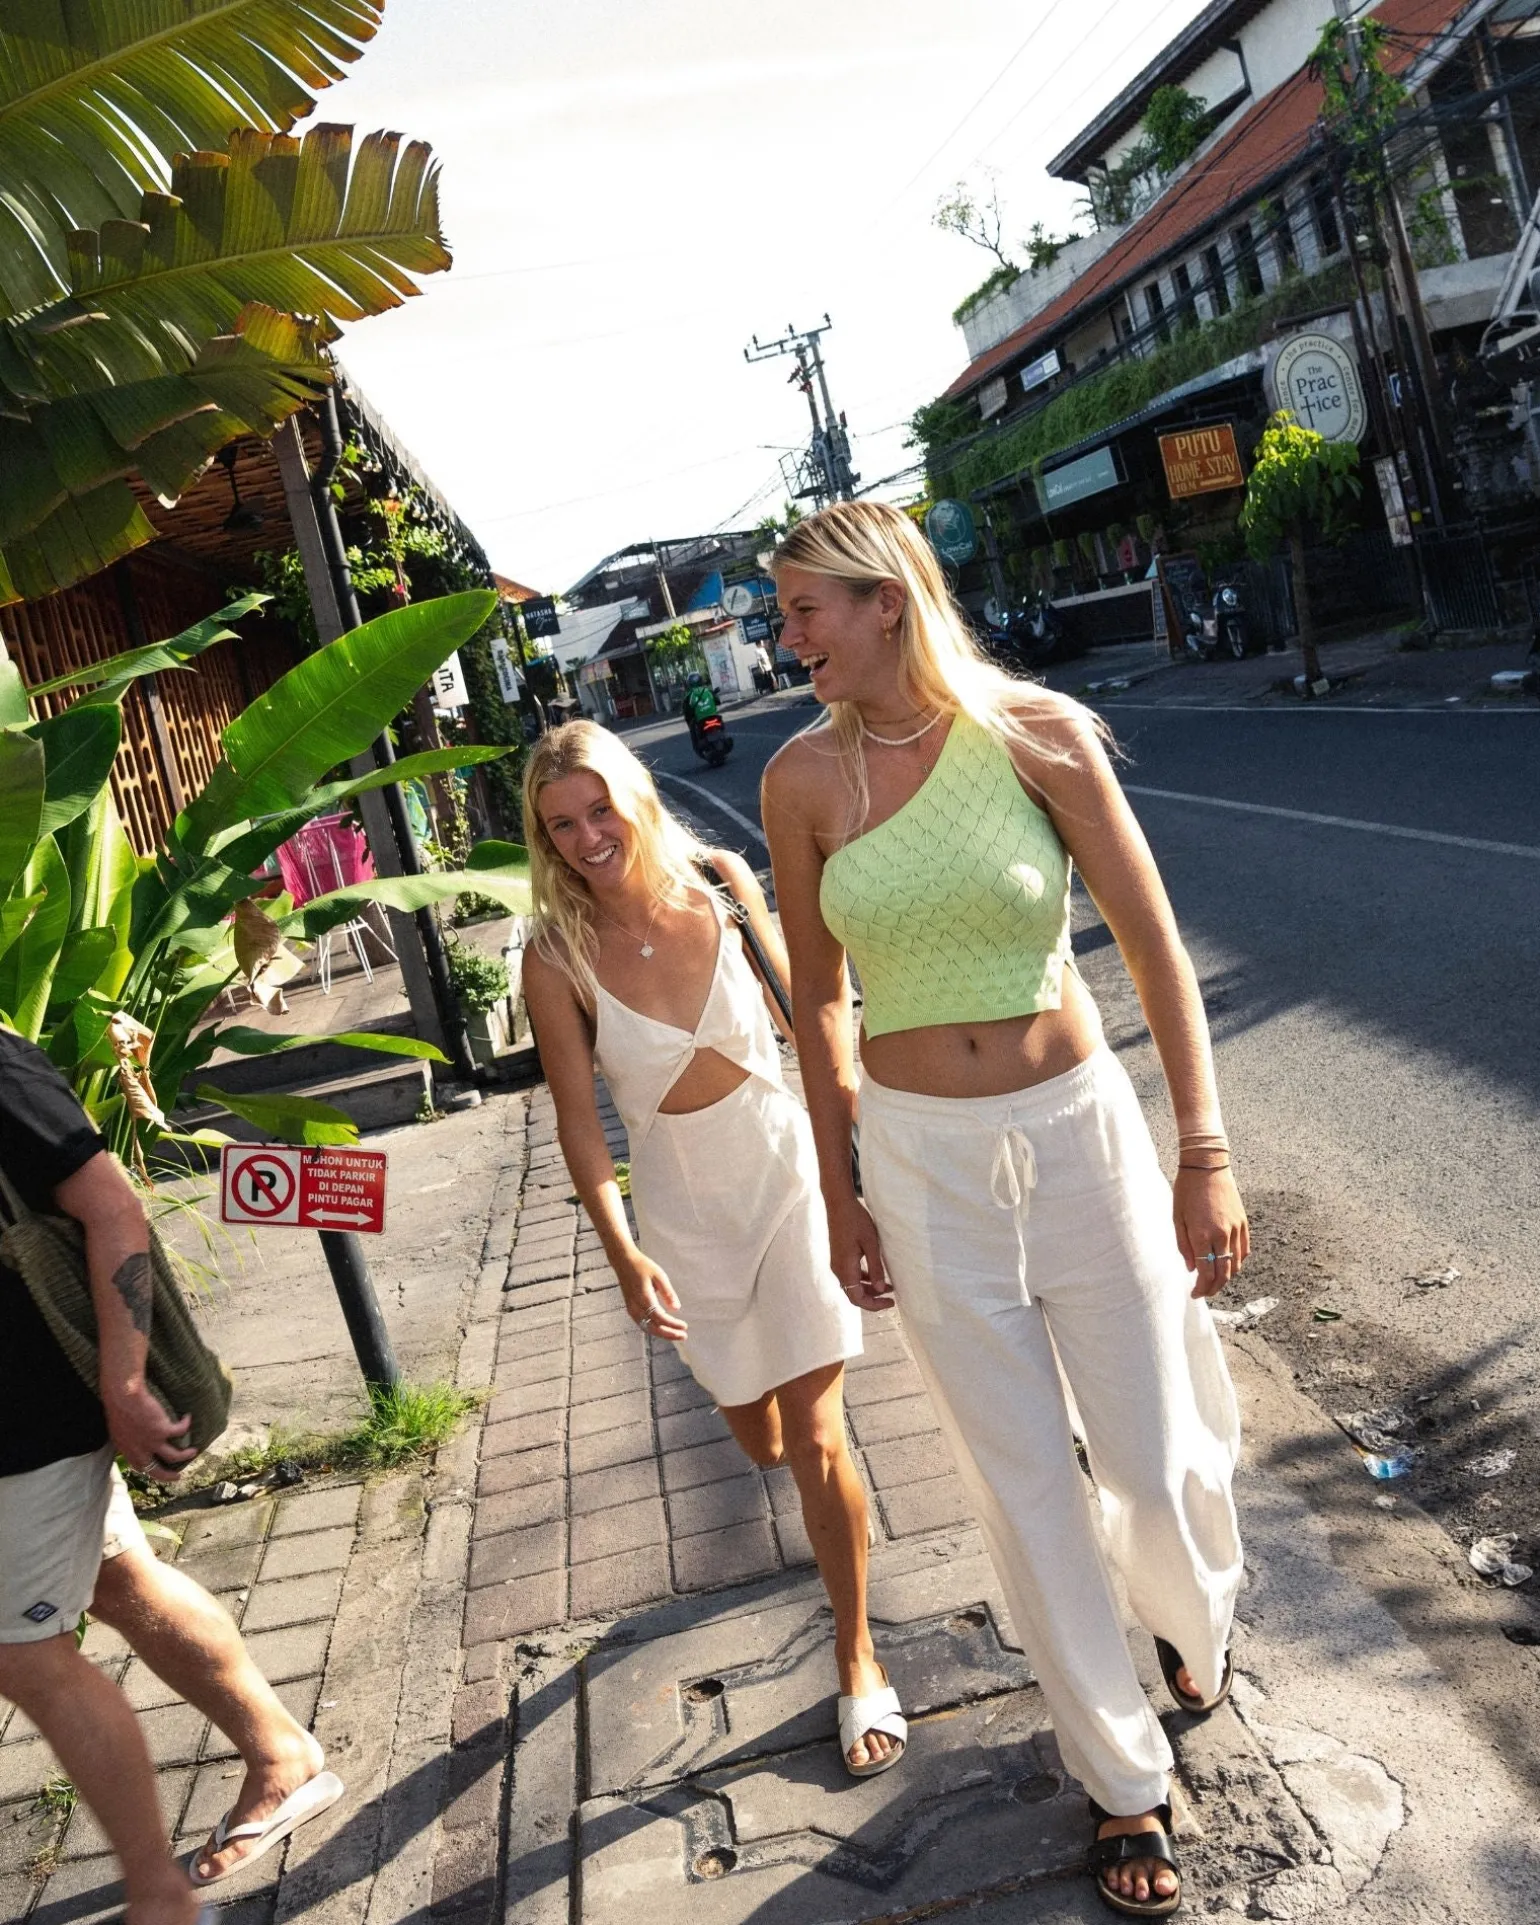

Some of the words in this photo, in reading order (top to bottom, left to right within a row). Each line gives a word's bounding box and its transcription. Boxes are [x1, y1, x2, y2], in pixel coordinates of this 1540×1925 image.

[1285, 348, 1298, 361] the
[1298, 339, 1334, 352] practice
[1308, 365, 1323, 375] The
[1296, 374, 1338, 395] Prac
[1343, 366, 1355, 395] center
[1301, 394, 1341, 428] tice
[1175, 430, 1220, 460] PUTU
[1168, 460, 1203, 484] HOME
[1206, 453, 1236, 476] STAY
[942, 541, 973, 555] LowCal
[525, 608, 552, 620] NATASHA
[438, 668, 455, 693] ITA
[346, 1157, 383, 1169] UNTUK
[308, 1168, 337, 1179] TIDAK
[340, 1170, 376, 1182] PARKIR
[319, 1181, 329, 1191] DI
[332, 1183, 364, 1195] DEPAN
[308, 1193, 338, 1205] PINTU
[341, 1196, 374, 1208] PAGAR
